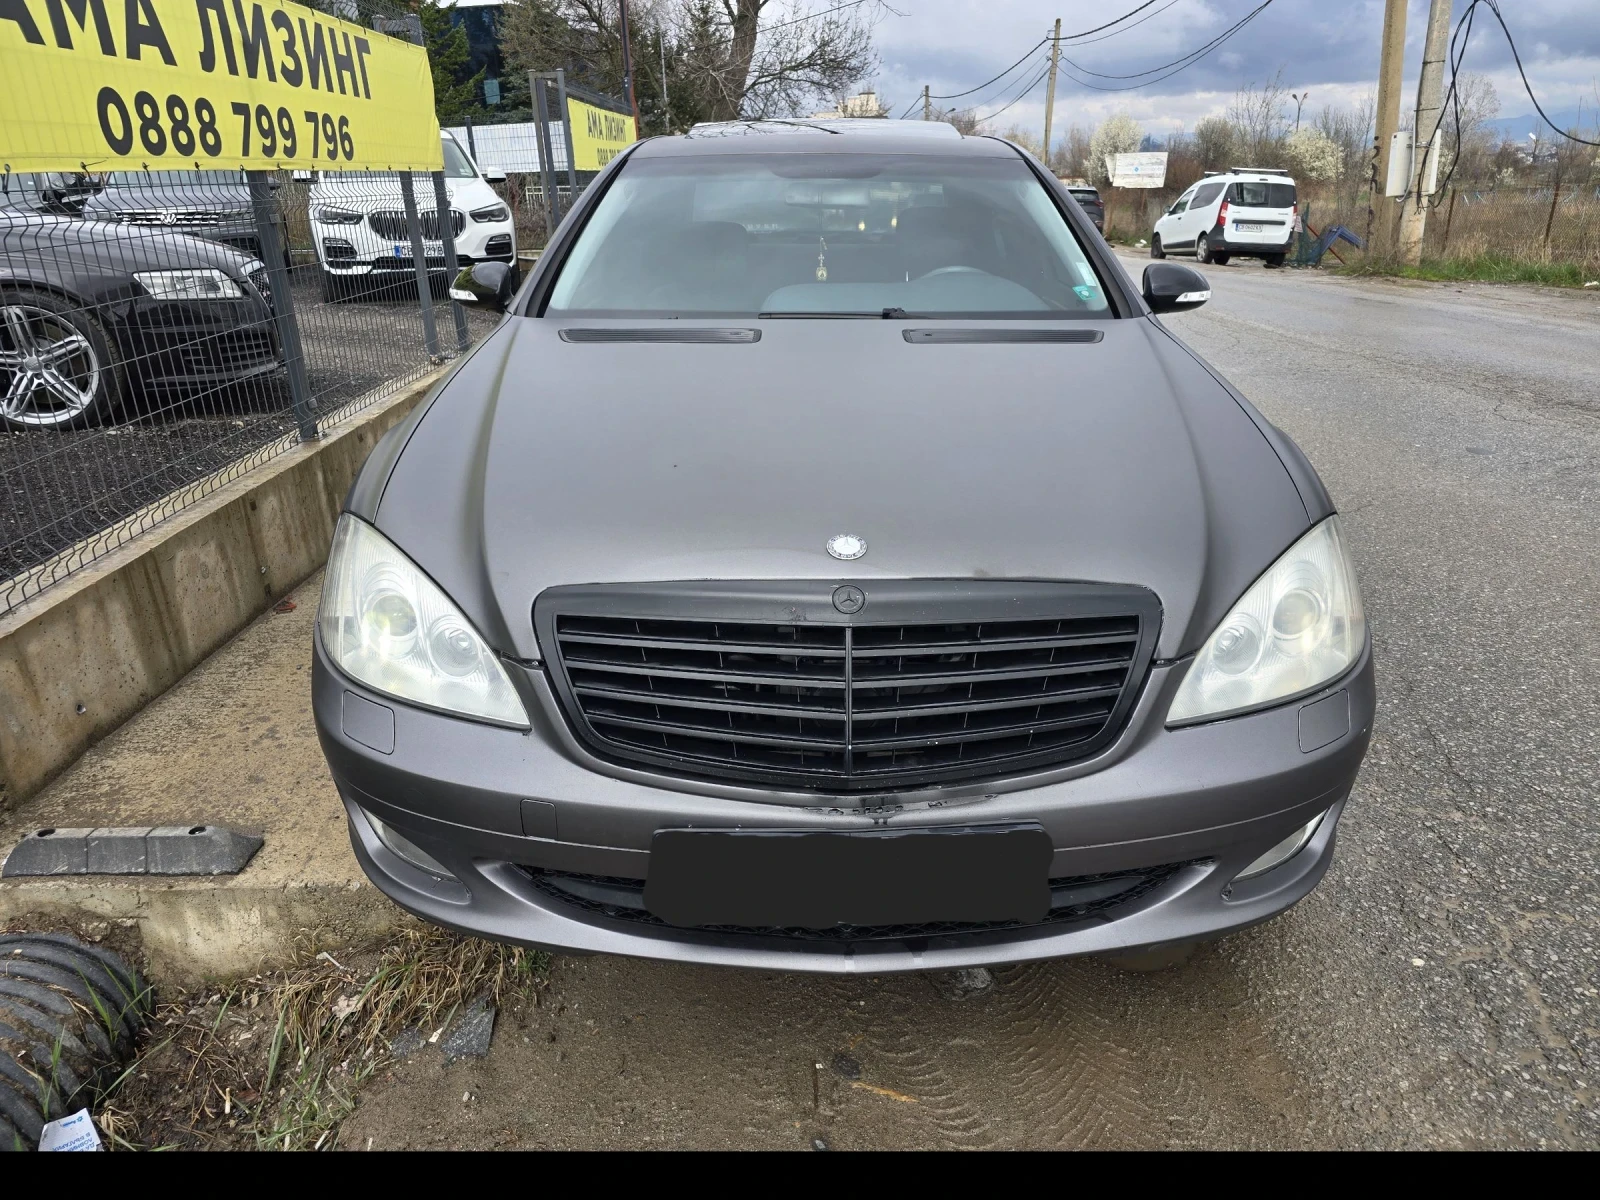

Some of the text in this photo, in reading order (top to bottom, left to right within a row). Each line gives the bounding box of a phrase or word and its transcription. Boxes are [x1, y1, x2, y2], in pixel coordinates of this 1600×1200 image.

[198, 0, 371, 100] ЛИЗИНГ
[97, 86, 354, 161] 0888 799 796
[587, 109, 604, 140] АМА
